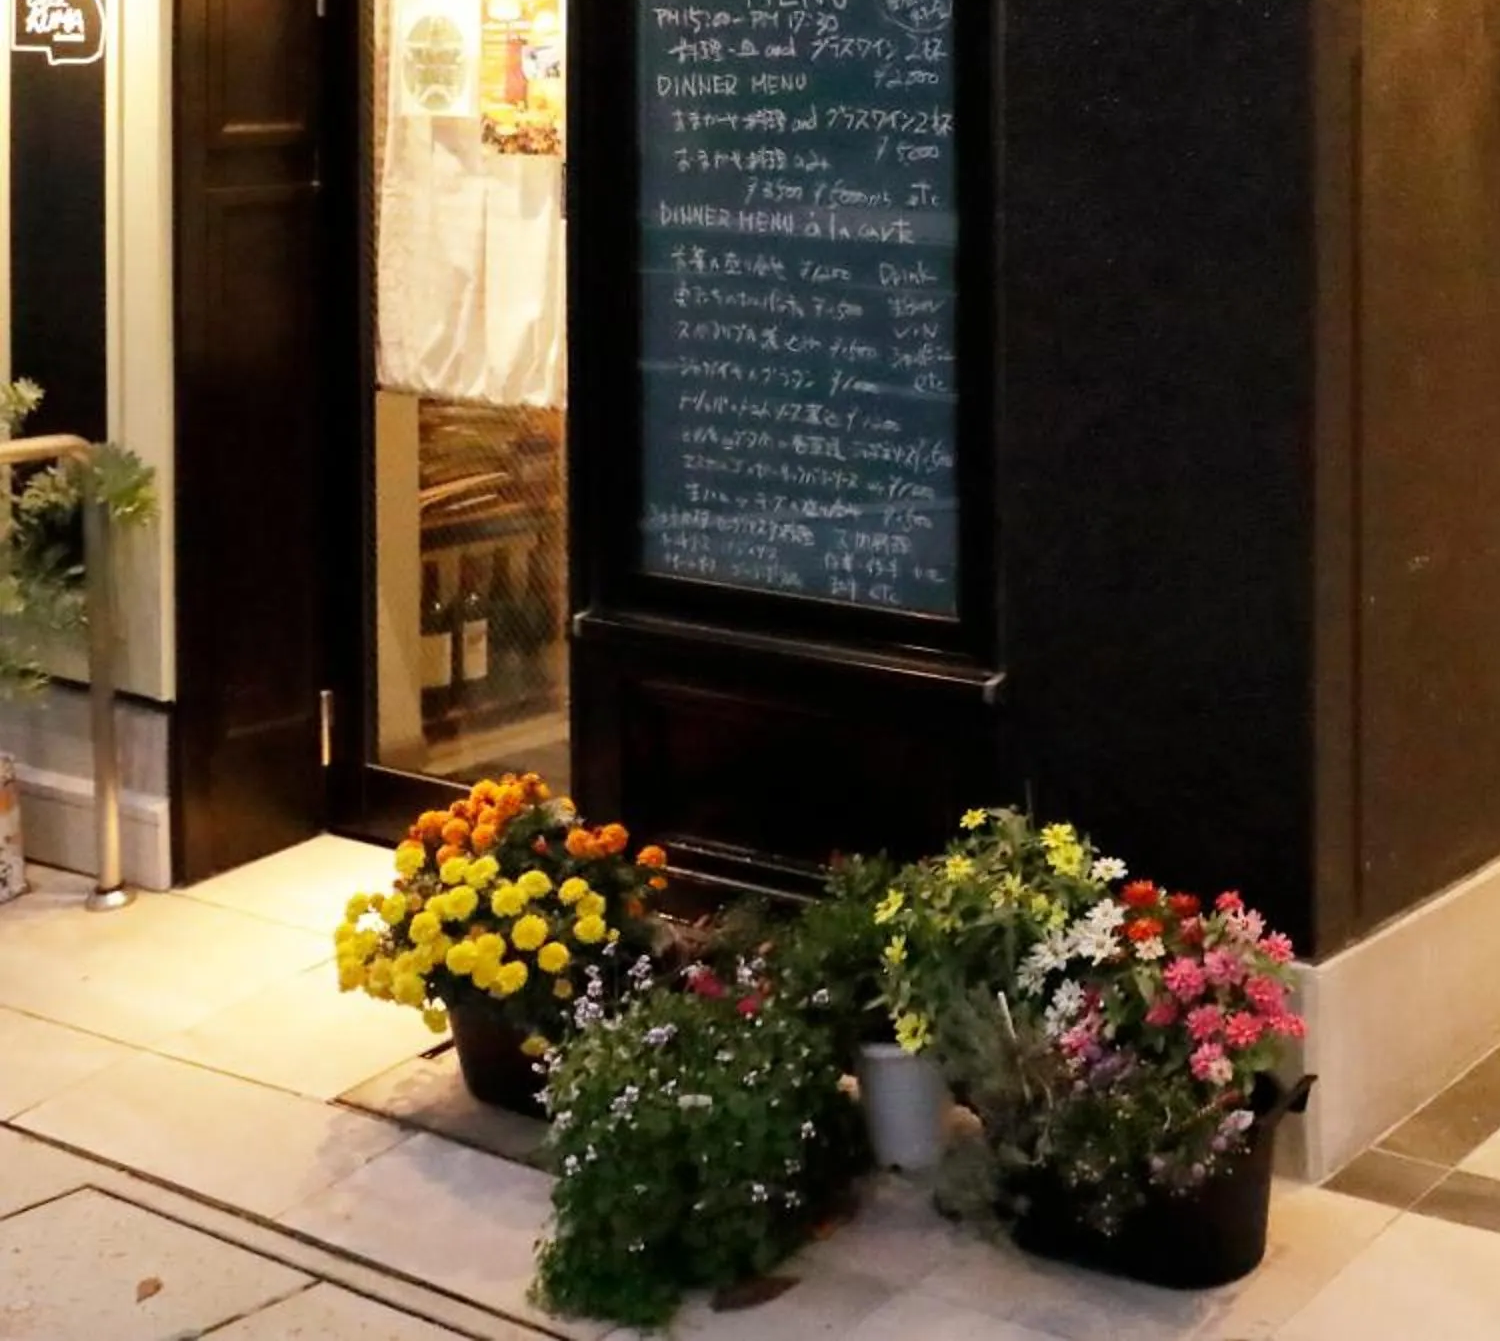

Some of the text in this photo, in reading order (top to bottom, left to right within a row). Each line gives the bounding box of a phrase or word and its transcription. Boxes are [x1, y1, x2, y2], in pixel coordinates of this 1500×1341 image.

[656, 69, 808, 98] DINNER MENU
[659, 199, 730, 229] DINNER
[738, 209, 796, 236] MENU
[878, 259, 939, 288] Drink
